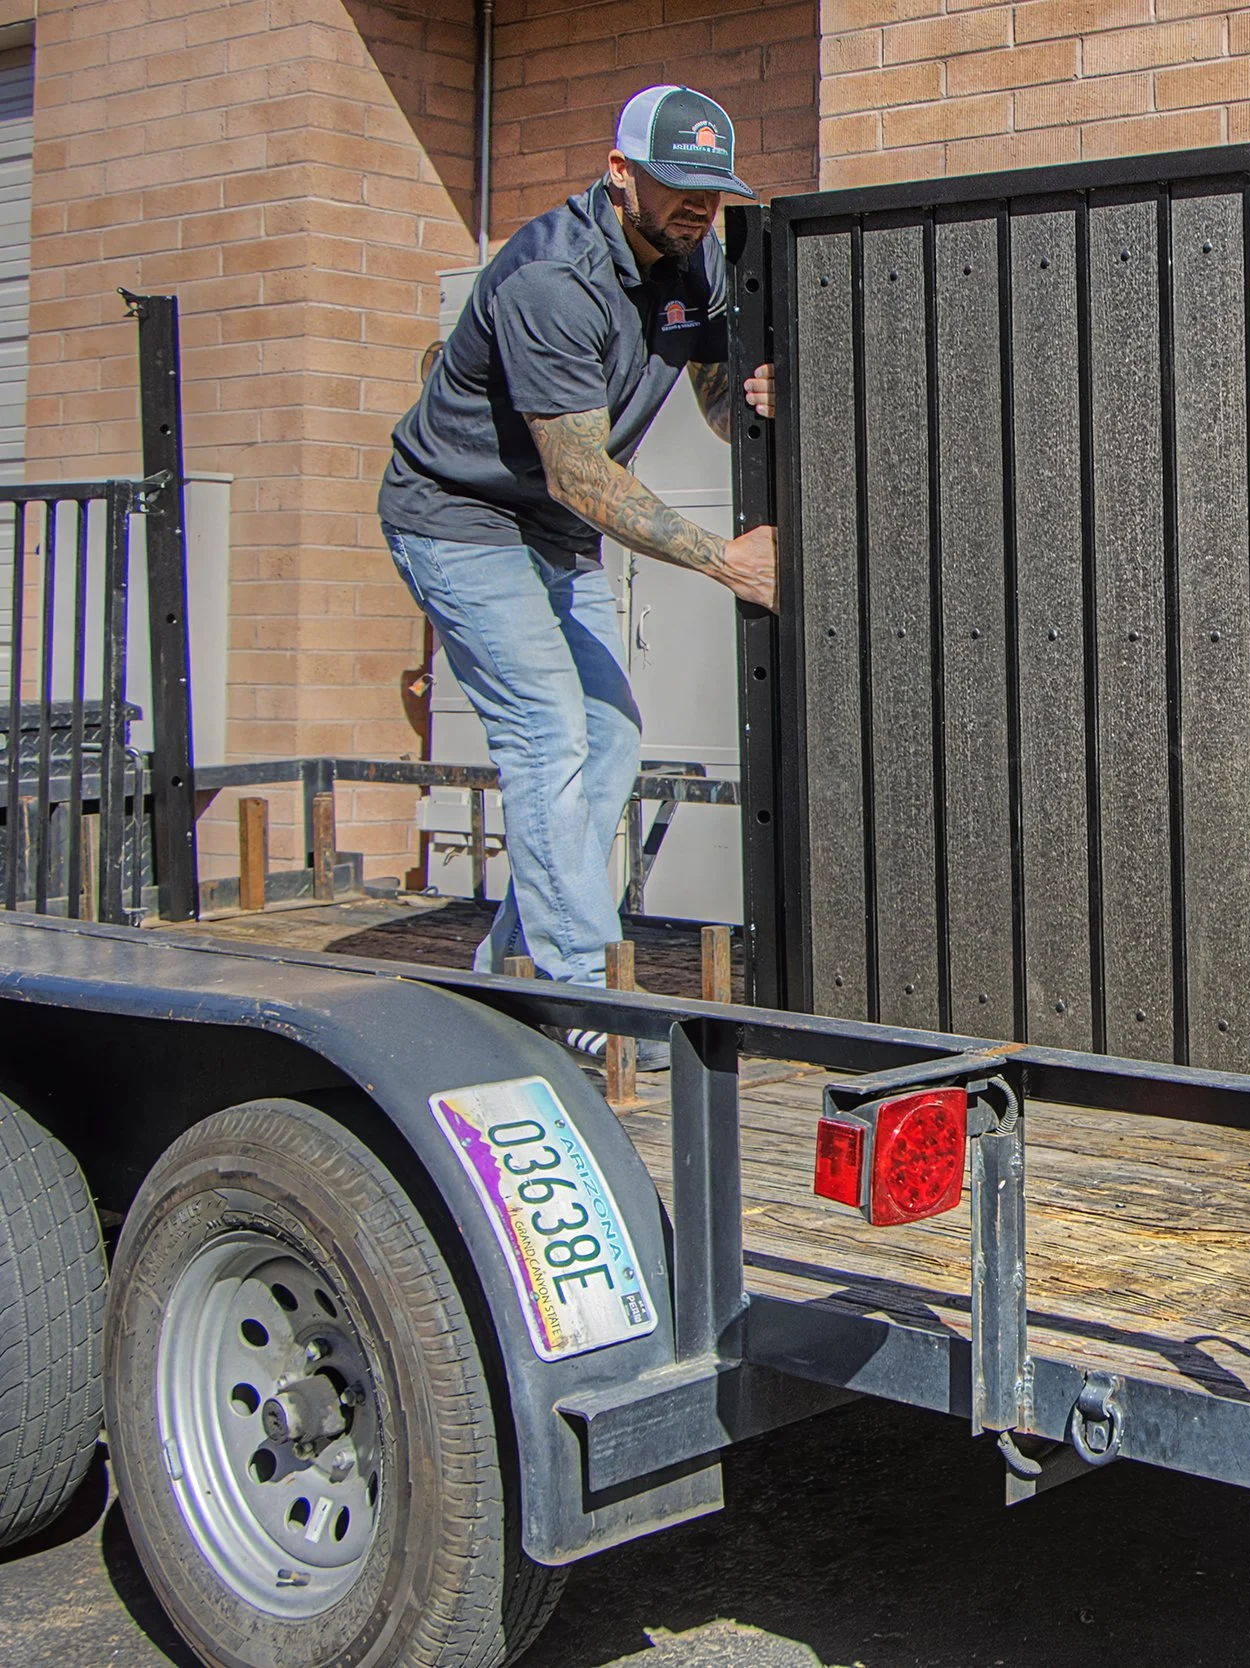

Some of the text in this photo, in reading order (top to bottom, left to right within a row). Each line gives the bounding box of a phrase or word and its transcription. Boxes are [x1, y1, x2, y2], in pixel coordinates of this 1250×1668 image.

[488, 1119, 615, 1305] 03638E
[559, 1137, 623, 1262] ARIZONA
[514, 1220, 562, 1335] GRAND CANYON STATE
